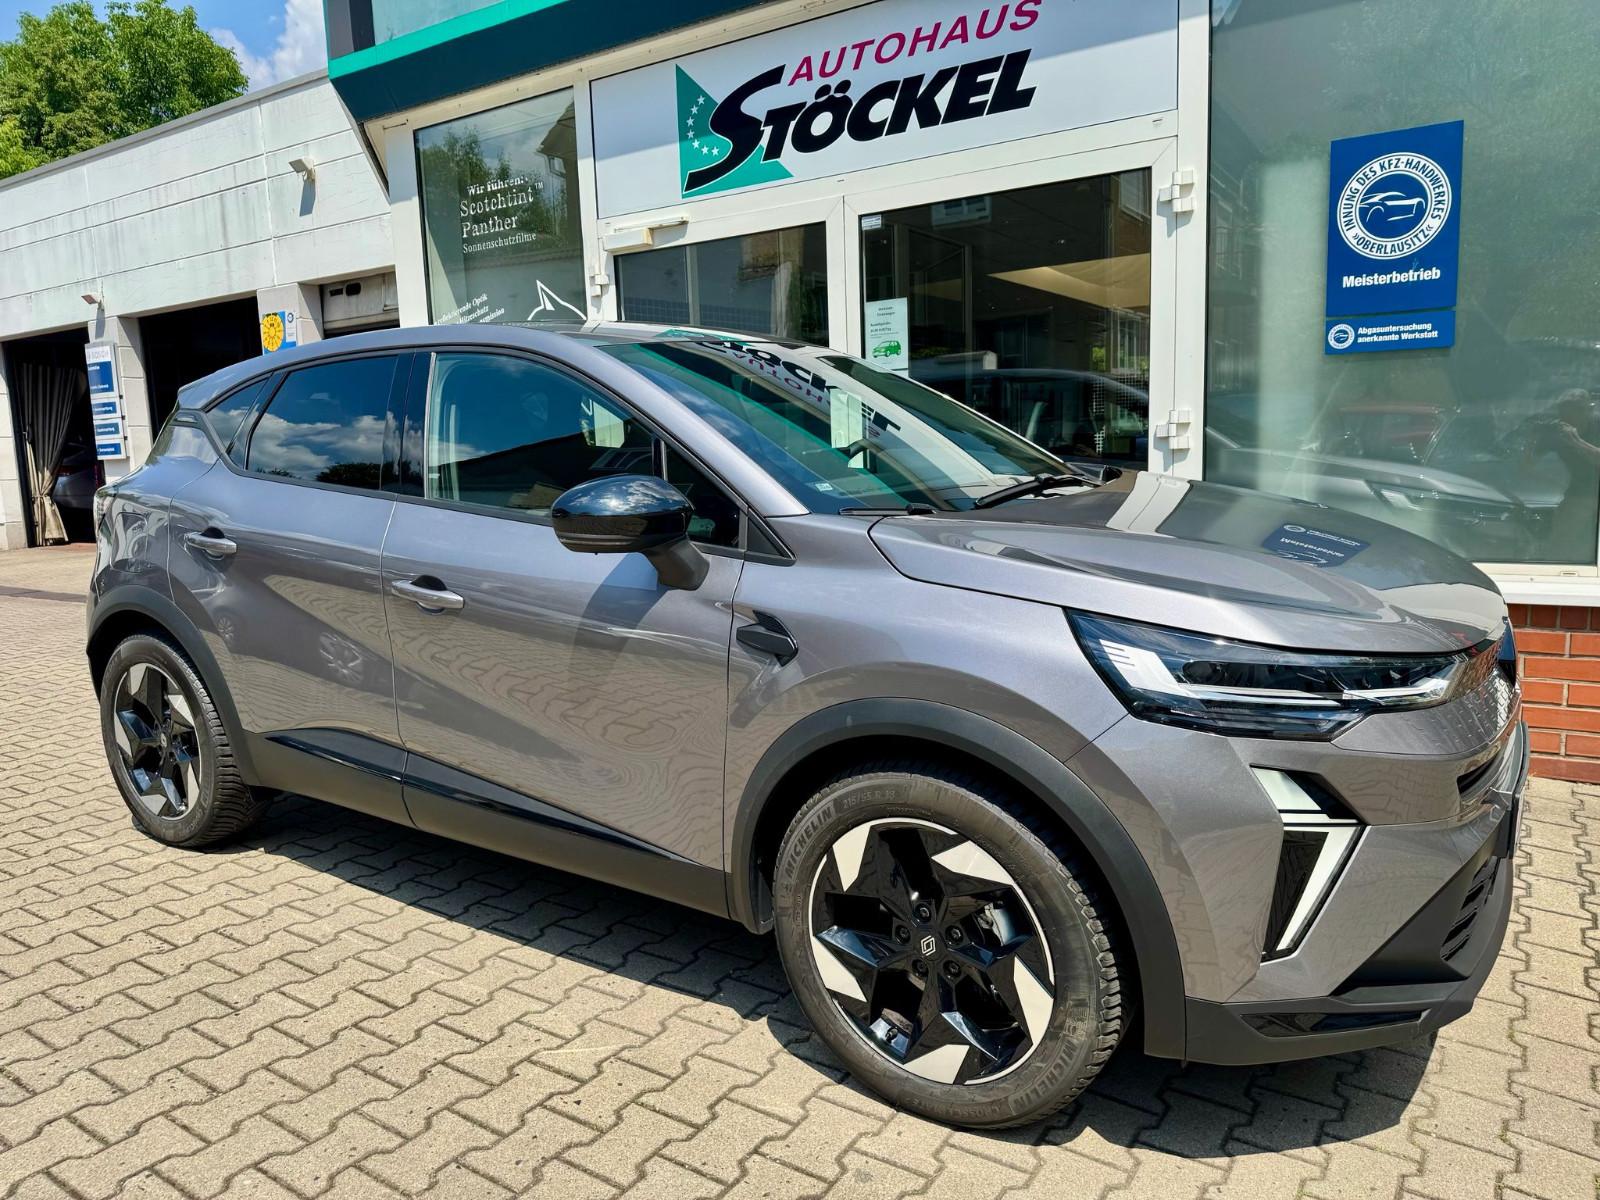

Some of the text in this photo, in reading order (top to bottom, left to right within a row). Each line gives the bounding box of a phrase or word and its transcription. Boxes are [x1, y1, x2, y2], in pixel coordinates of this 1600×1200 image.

[788, 0, 1042, 86] AUTOHAUS
[684, 49, 1036, 192] STÖCKEL
[460, 187, 534, 217] Scotchtint
[467, 184, 485, 196] Wir
[1342, 157, 1446, 232] INNUNG DES KFZ-HANDWERKES
[462, 215, 518, 238] Panther
[463, 232, 537, 253] Sonnenschutzfilme
[1343, 266, 1440, 288] Meisterbetrieb
[1357, 323, 1432, 335] Abgasuntersuchung
[1357, 331, 1438, 343] anerkannte Werkstatt
[785, 806, 832, 879] MICHELIN
[1014, 1037, 1080, 1111] MICHELIN
